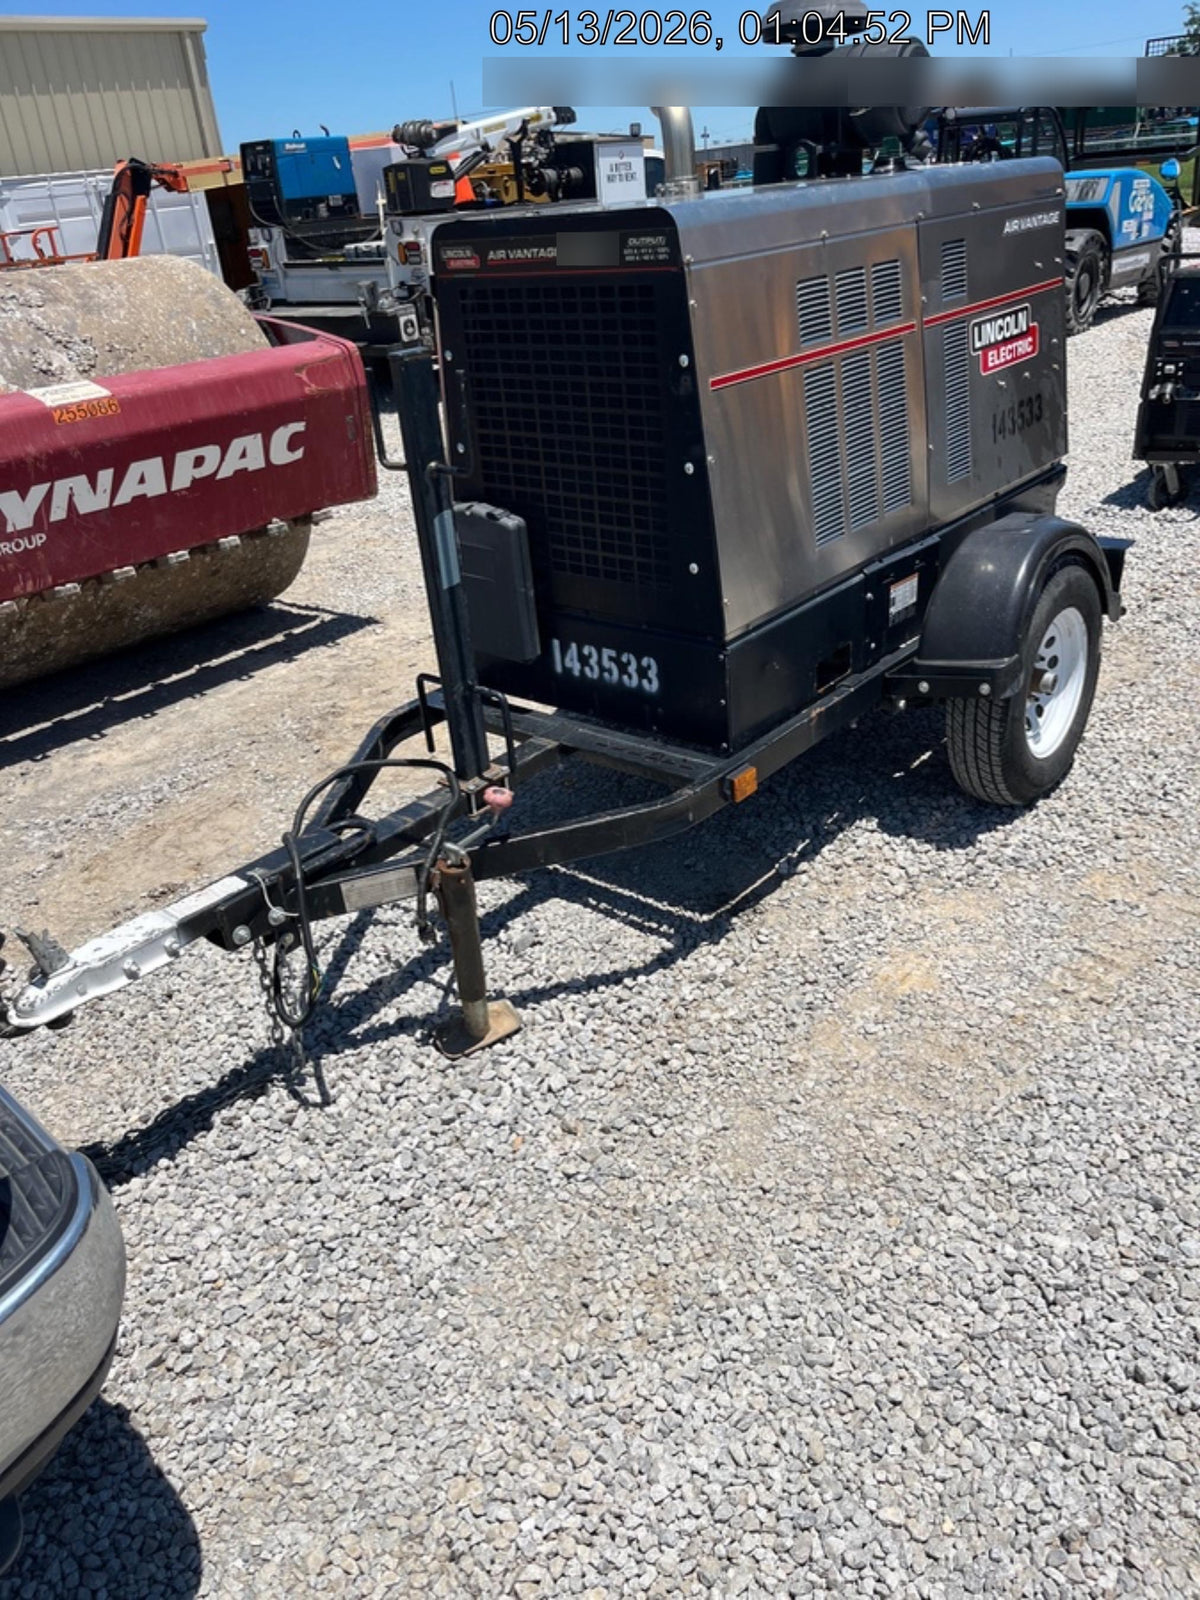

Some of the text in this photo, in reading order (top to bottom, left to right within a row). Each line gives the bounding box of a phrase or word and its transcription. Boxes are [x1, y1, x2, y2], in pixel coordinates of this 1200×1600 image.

[973, 310, 1028, 349] LINCOLN
[987, 336, 1034, 368] ELECTRIC
[56, 399, 118, 423] 255086
[991, 394, 1043, 445] 143533
[0, 533, 47, 556] ROUP
[552, 638, 660, 693] 143533
